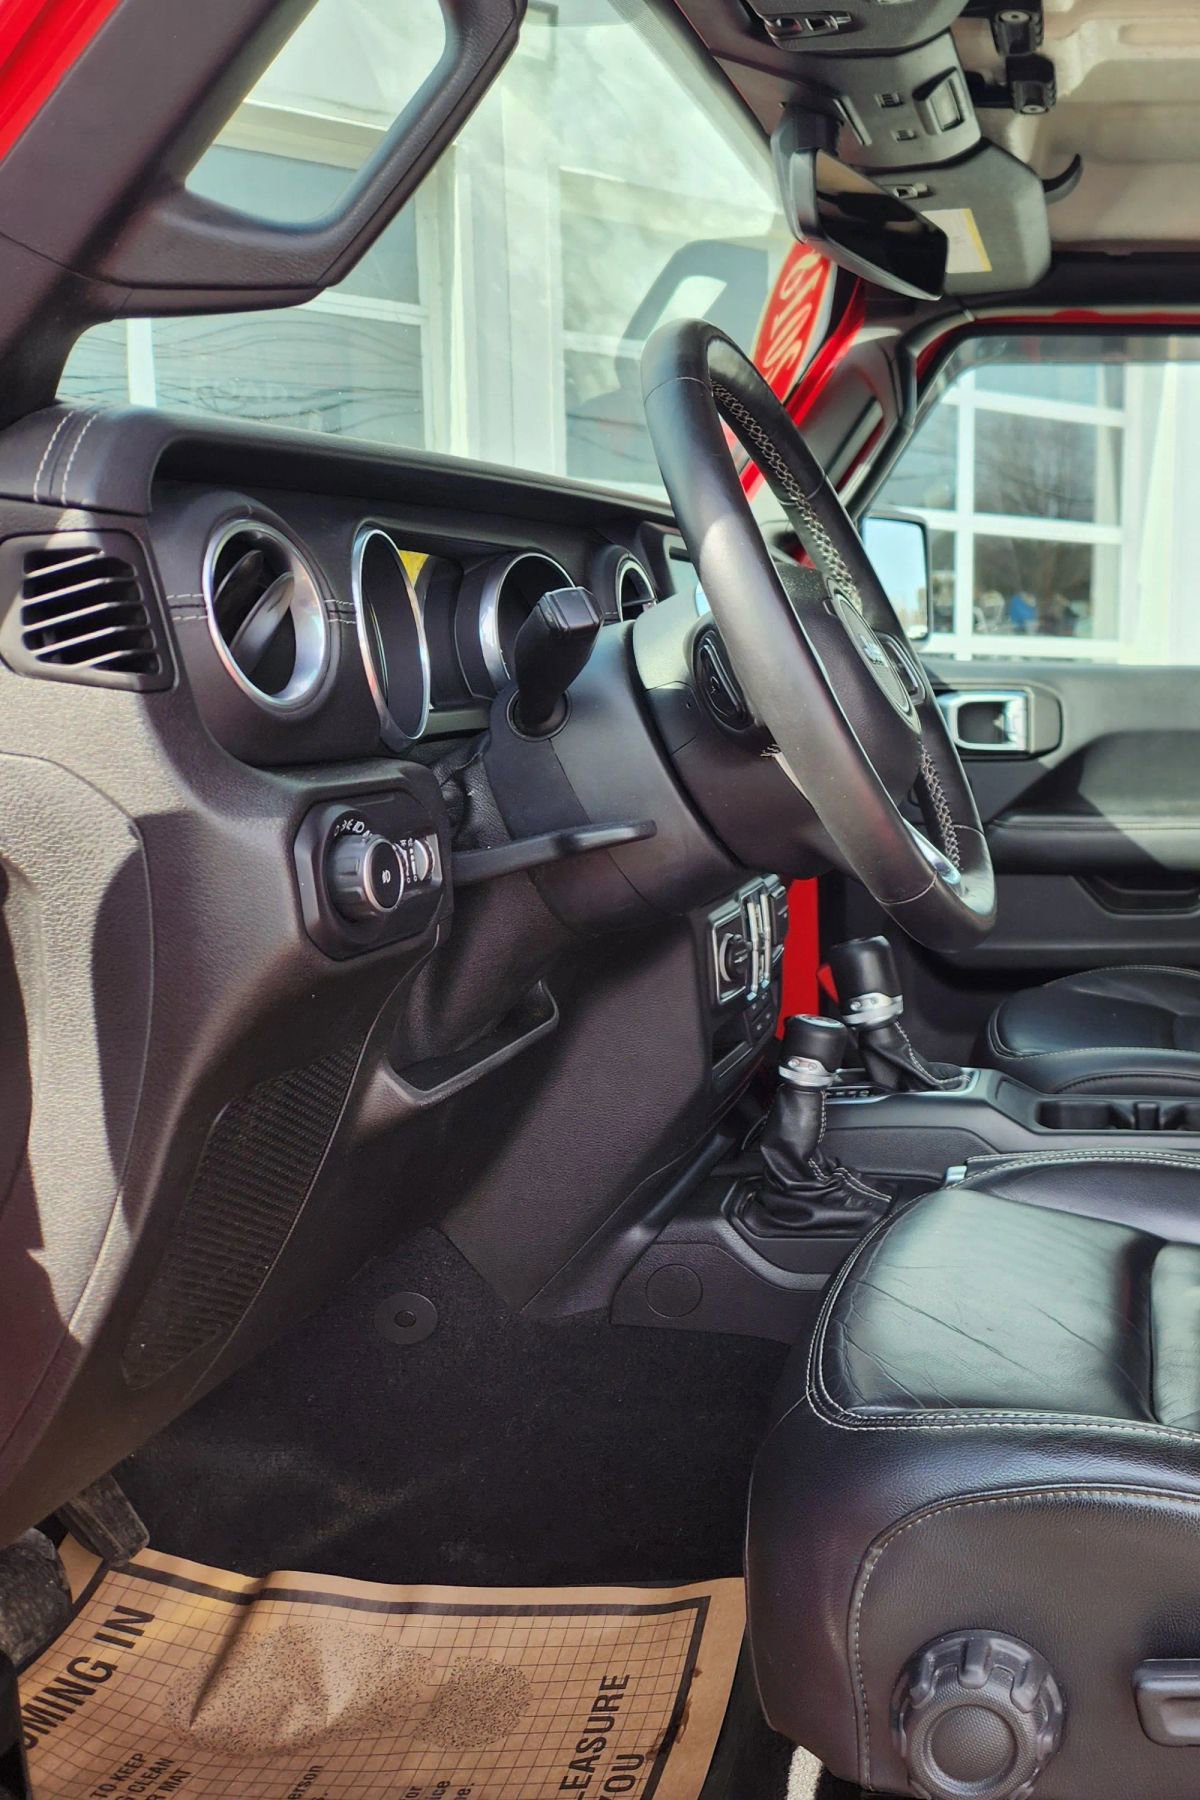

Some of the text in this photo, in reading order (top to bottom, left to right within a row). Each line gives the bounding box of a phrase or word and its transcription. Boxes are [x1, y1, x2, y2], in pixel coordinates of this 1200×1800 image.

[93, 1605, 155, 1649] IN
[559, 1674, 630, 1800] EASURE
[90, 1753, 147, 1798] TO KEEP
[127, 1757, 175, 1793] CLEAN
[158, 1769, 192, 1792] MAT
